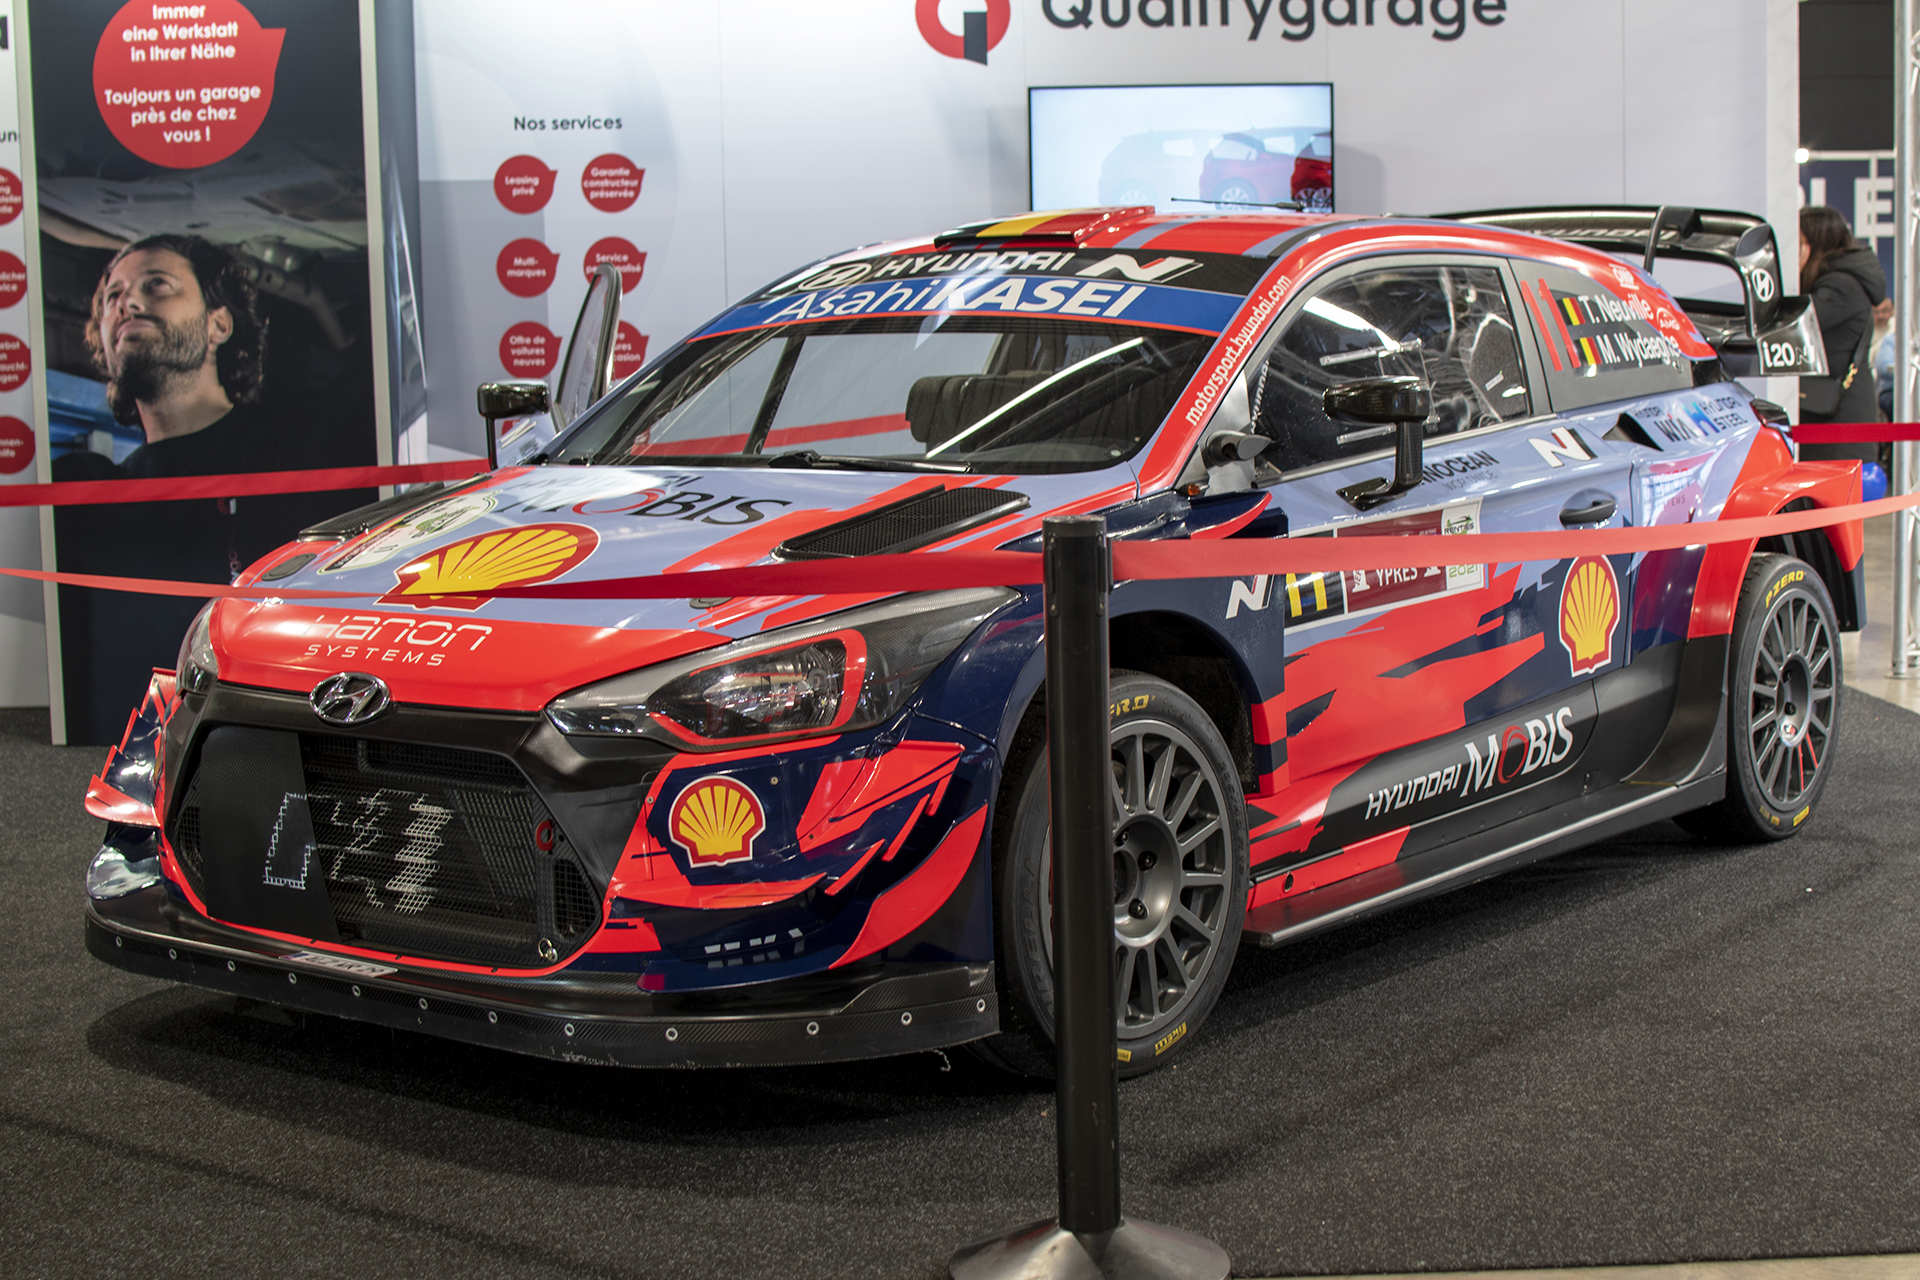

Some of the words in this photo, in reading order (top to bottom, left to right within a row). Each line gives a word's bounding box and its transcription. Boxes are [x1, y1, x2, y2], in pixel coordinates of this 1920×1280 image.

[152, 4, 206, 20] Immer
[122, 25, 158, 42] eine
[162, 21, 239, 41] Werkstatt
[131, 46, 146, 62] in
[150, 44, 187, 61] Ihrer
[191, 42, 236, 59] Nähe
[104, 89, 171, 107] Toujours
[175, 88, 196, 102] un
[199, 85, 261, 104] garage
[131, 108, 166, 127] près
[170, 107, 193, 123] de
[197, 105, 237, 122] chez
[514, 116, 546, 131] Nos
[552, 115, 623, 130] services
[163, 129, 202, 144] vous
[591, 167, 630, 177] Garantie
[505, 175, 540, 187] Leasing
[583, 178, 639, 188] constructeur
[512, 186, 535, 198] privé
[589, 188, 635, 200] préservée
[1526, 229, 1679, 241] YUNDAI
[513, 256, 539, 266] Multi-
[595, 253, 629, 263] Service
[874, 252, 1076, 279] HYUNDAI
[507, 267, 546, 278] marques
[1577, 295, 1600, 324] T.
[1594, 293, 1654, 323] Neuville
[509, 335, 532, 345] Offre
[533, 334, 546, 344] de
[510, 346, 546, 356] voitures
[1185, 275, 1292, 426] motorsport.hyundai.com
[1596, 333, 1621, 364] M.
[1762, 340, 1796, 368] i20
[513, 358, 546, 367] neuves
[1713, 412, 1749, 432] STEEL
[497, 488, 793, 526] MOBIS
[1375, 566, 1418, 587] YPRES
[1448, 563, 1479, 578] 2021
[1772, 570, 1804, 598] ZERO
[304, 644, 446, 667] SYSTEMS
[1364, 763, 1463, 821] HYUNDAI
[1459, 706, 1574, 798] MOBIS
